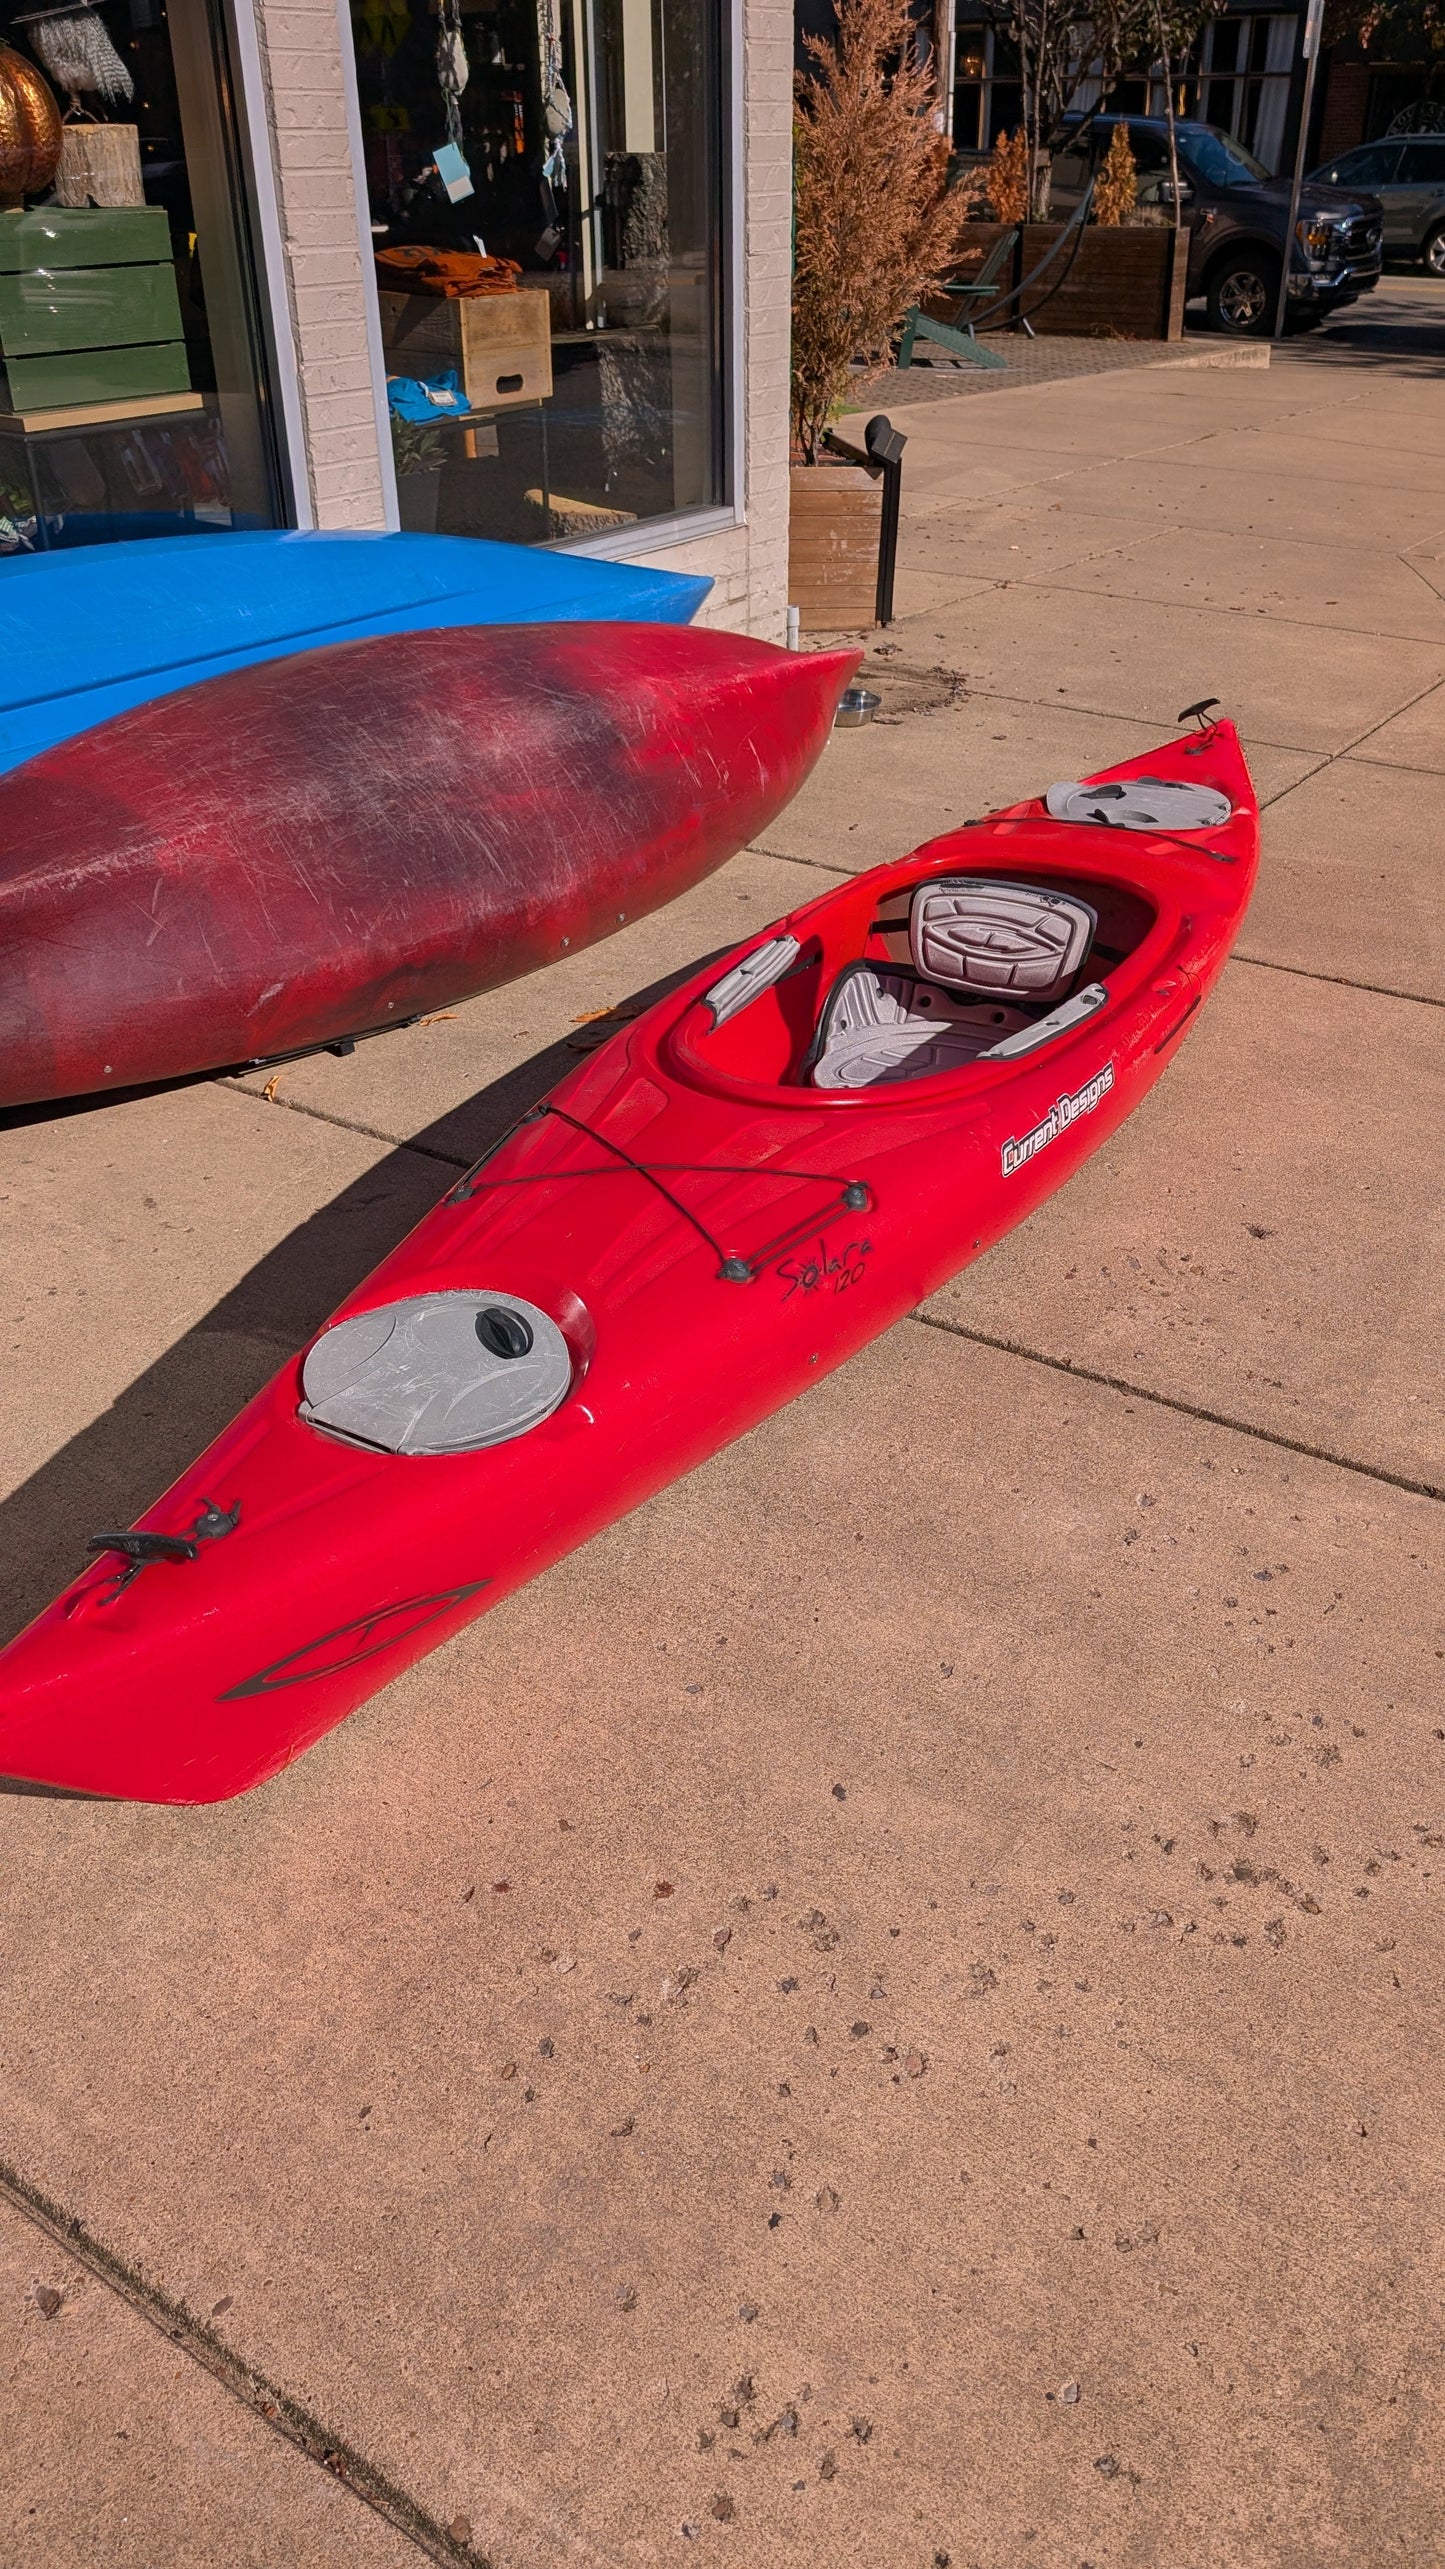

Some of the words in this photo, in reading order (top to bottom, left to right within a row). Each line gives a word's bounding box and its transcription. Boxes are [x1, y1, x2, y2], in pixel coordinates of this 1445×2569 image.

[1002, 1107, 1059, 1177] Current
[1057, 1063, 1115, 1130] Designs
[776, 1238, 873, 1302] Solara
[834, 1262, 866, 1295] 120
